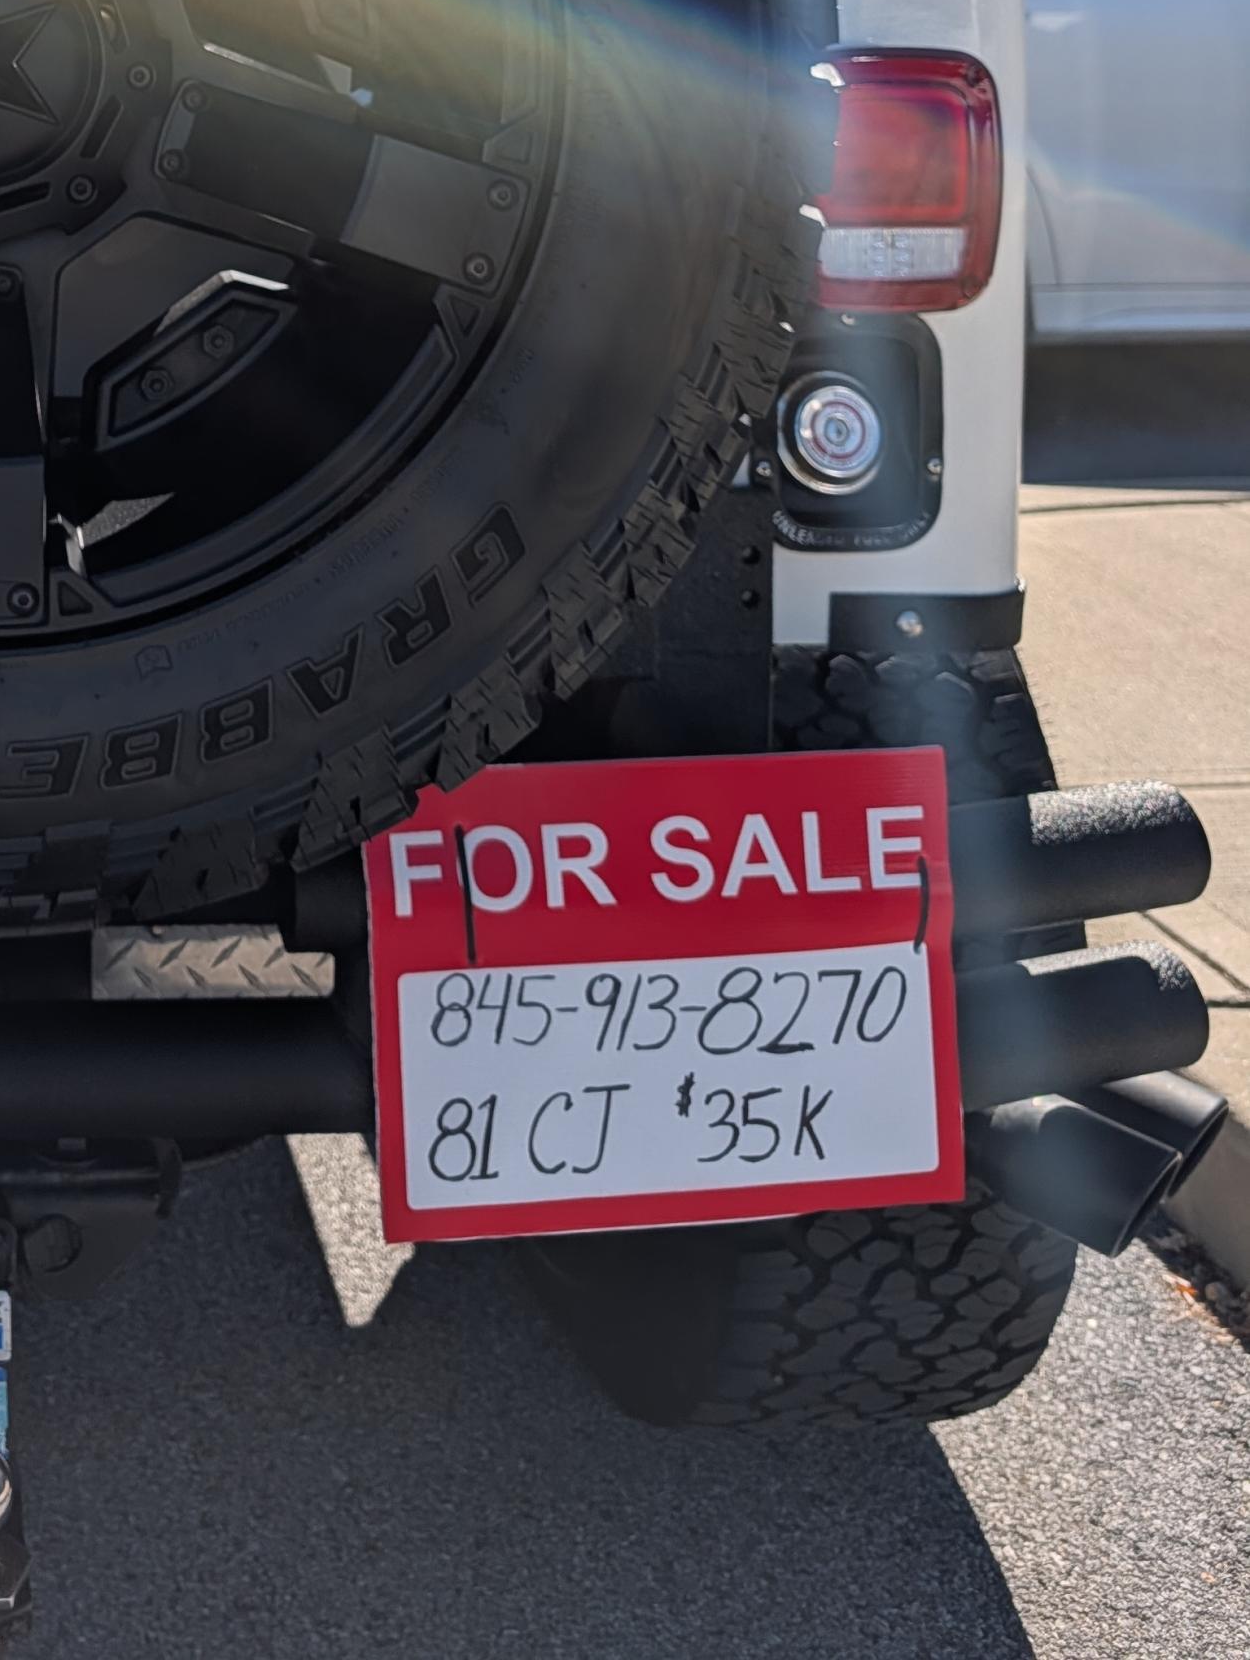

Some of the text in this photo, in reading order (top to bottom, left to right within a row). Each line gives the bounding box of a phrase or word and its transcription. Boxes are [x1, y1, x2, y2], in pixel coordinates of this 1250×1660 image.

[388, 805, 925, 918] FOR SALE
[431, 966, 908, 1055] 845-913-8270
[428, 1071, 833, 1182] 81 CJ $35K
